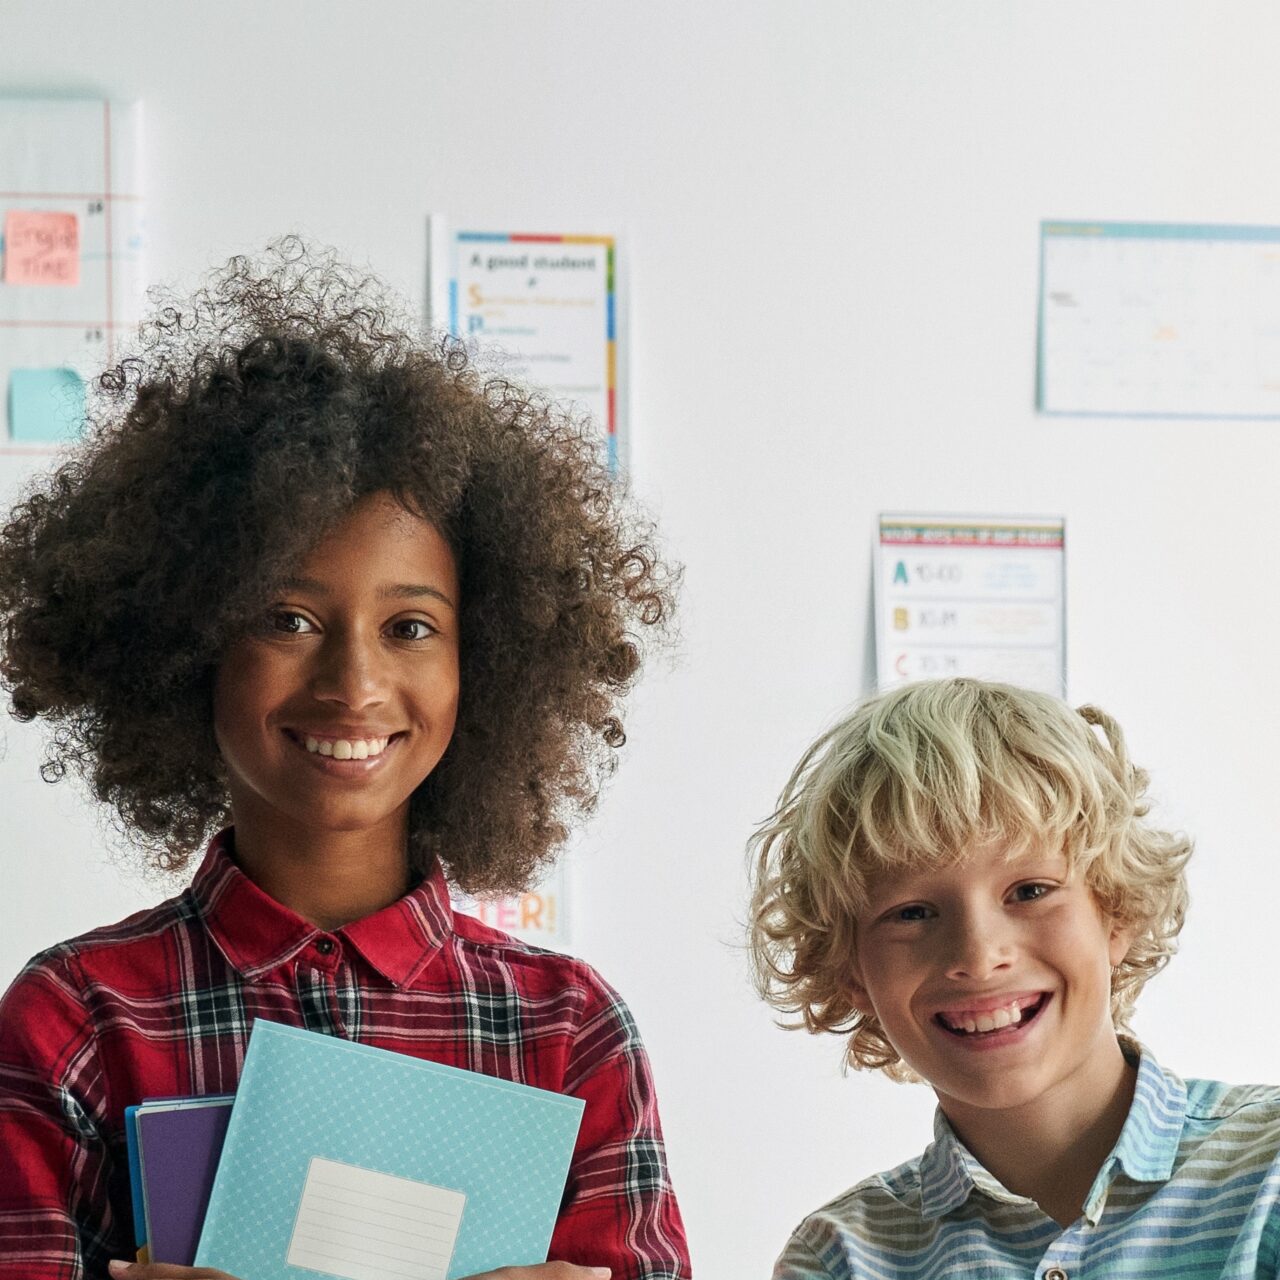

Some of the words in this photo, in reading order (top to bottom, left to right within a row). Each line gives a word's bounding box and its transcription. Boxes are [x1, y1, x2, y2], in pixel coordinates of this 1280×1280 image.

[471, 254, 481, 267] A
[487, 255, 528, 271] good
[534, 256, 596, 270] student
[893, 560, 909, 585] A
[893, 607, 910, 631] B
[895, 652, 909, 677] C
